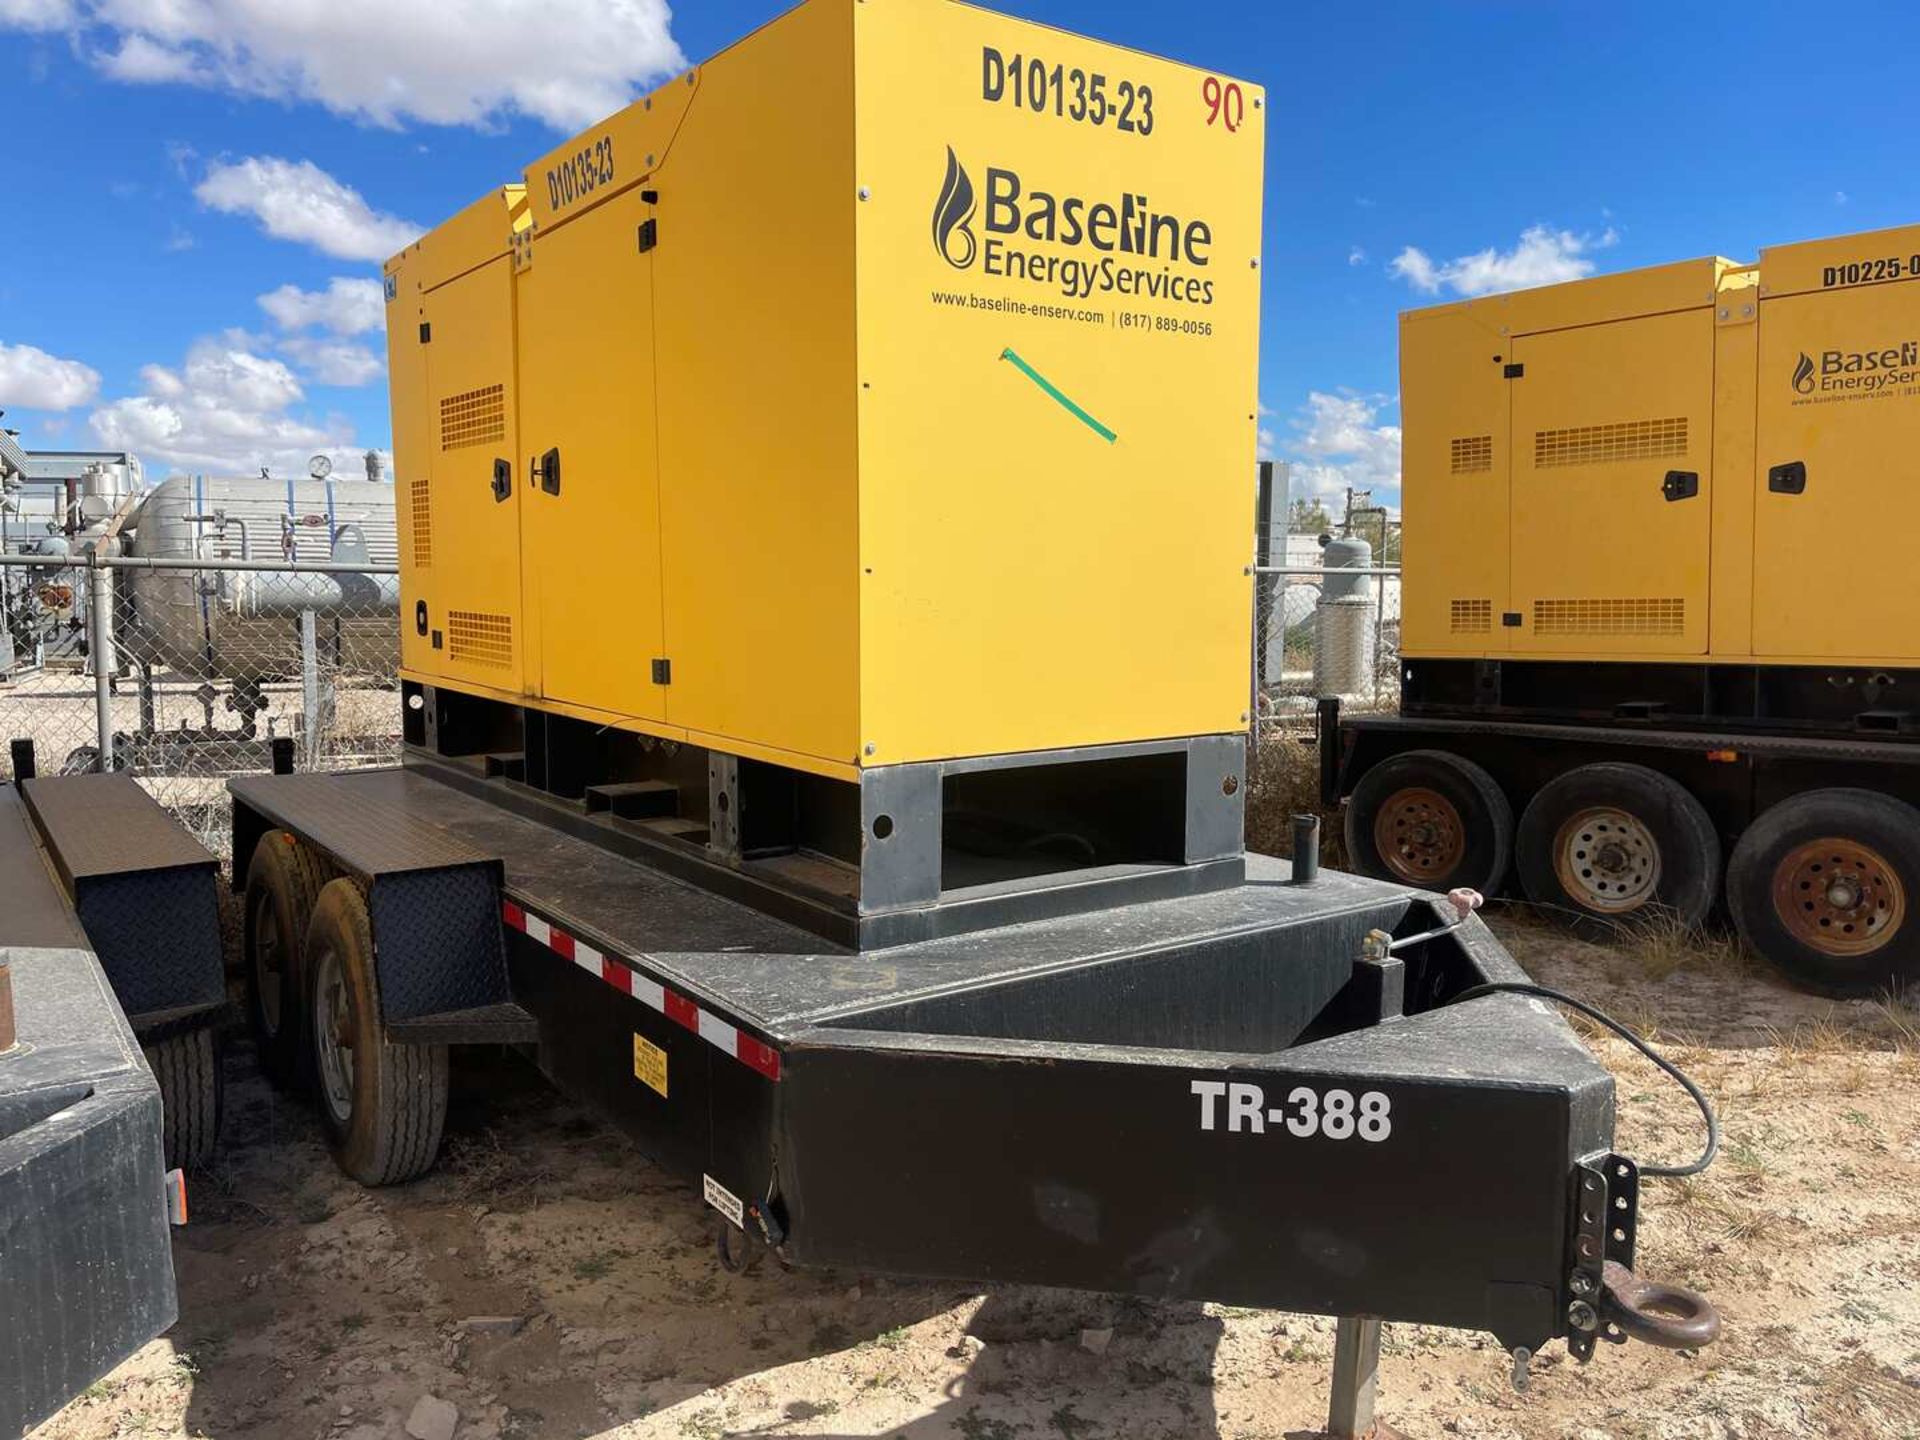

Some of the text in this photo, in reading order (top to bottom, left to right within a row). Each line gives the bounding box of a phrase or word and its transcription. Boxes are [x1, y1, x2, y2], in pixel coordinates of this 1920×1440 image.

[981, 46, 1154, 136] D10135-23
[1203, 76, 1243, 132] 90
[546, 135, 614, 212] D10135-23
[984, 166, 1212, 267] Baseline
[983, 238, 1213, 305] EnergyServices
[1823, 254, 1920, 288] D10225-0
[931, 291, 1212, 336] www.baseline-enserv.com (817) 889-0056
[1190, 1080, 1392, 1143] TR-388
